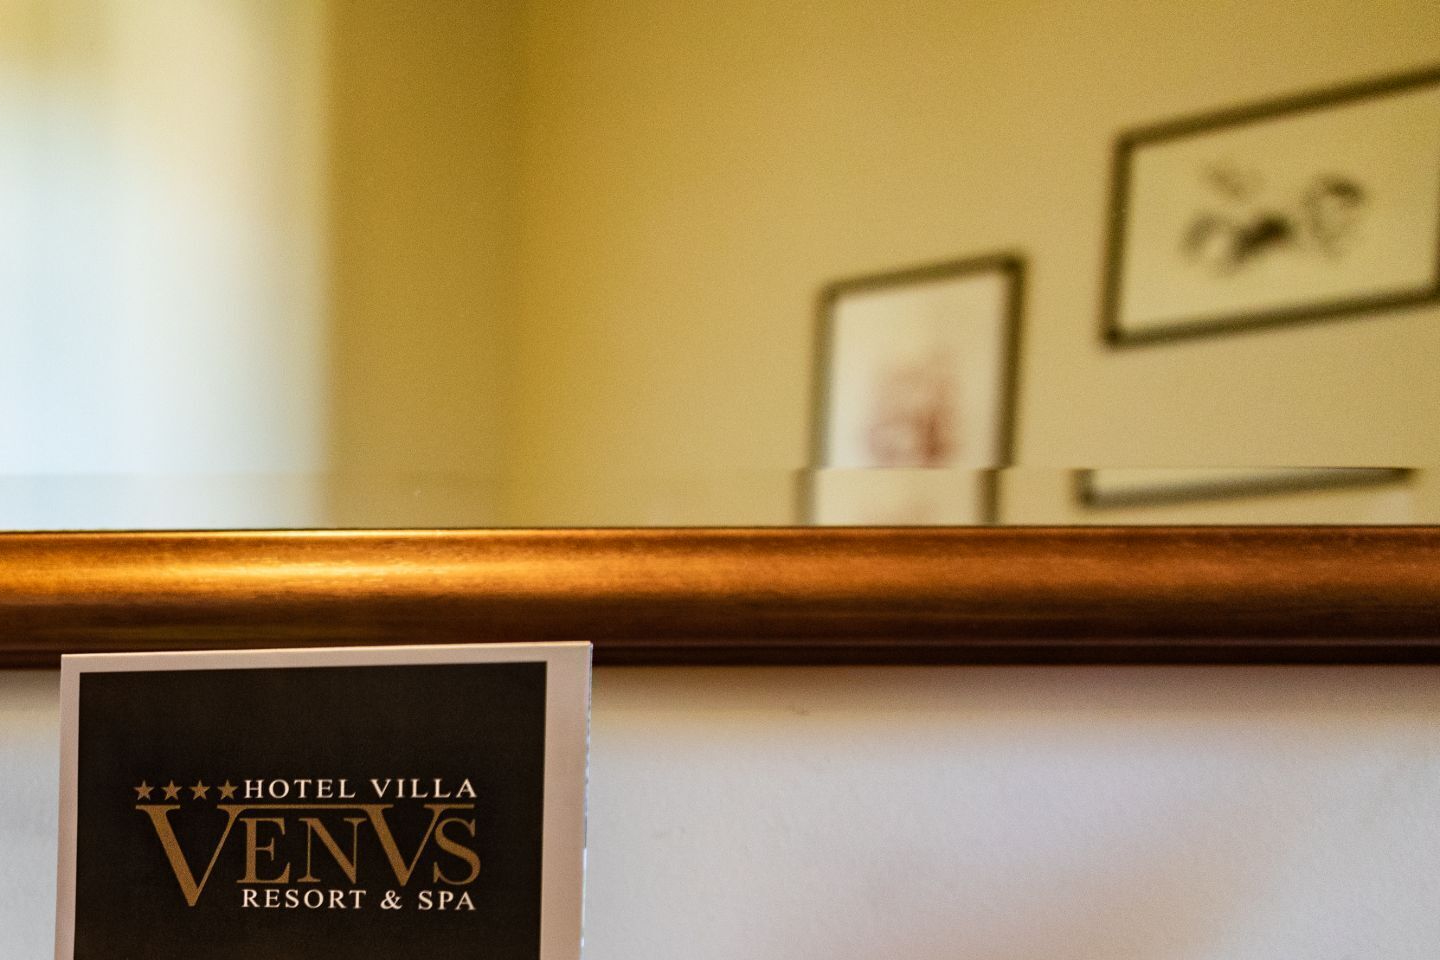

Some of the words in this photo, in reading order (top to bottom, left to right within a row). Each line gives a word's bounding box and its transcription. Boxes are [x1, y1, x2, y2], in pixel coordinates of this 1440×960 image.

[243, 778, 357, 799] HOTEL
[370, 777, 478, 799] VILLA
[241, 889, 367, 908] RESORT
[380, 891, 402, 910] &
[418, 891, 477, 911] SPA
